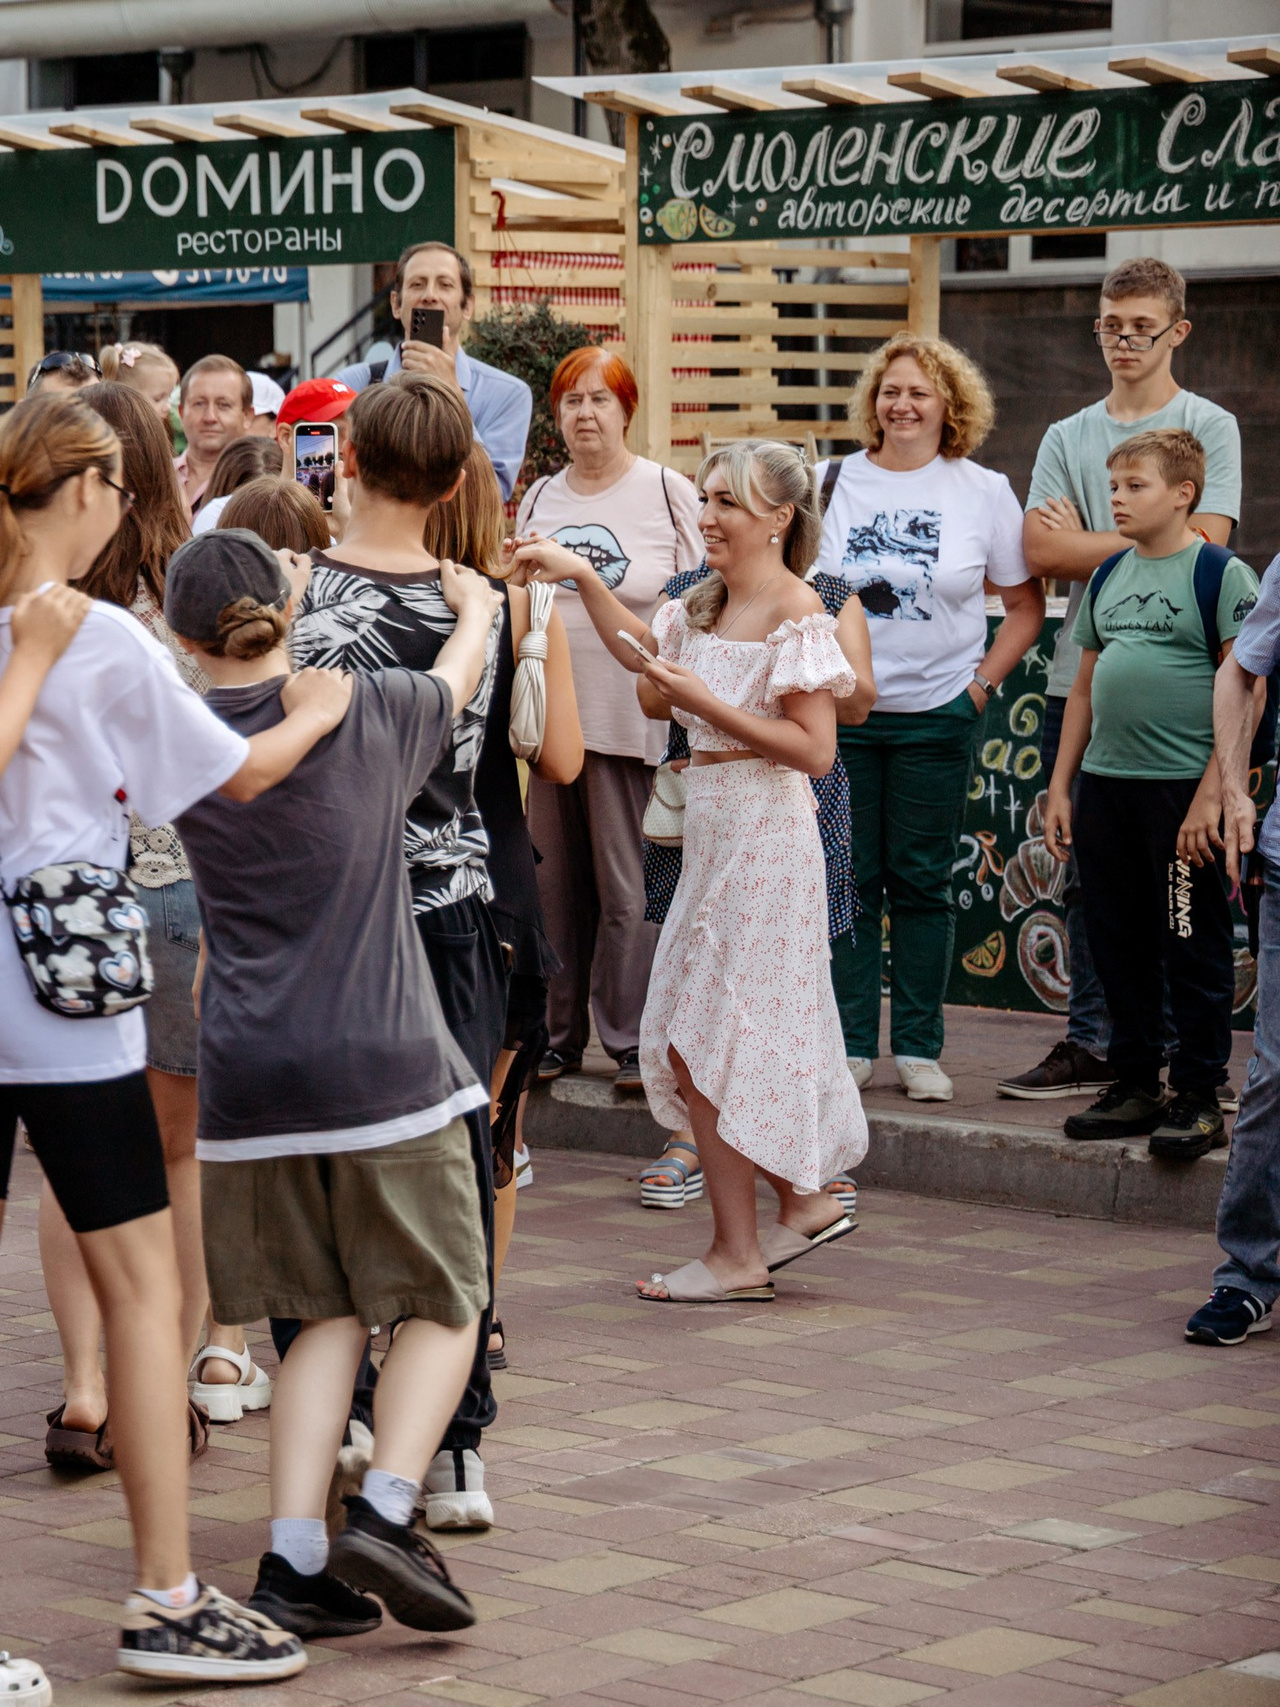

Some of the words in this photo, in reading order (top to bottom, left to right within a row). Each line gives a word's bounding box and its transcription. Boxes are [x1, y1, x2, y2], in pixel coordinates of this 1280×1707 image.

[669, 107, 1102, 199] Смоленские
[777, 185, 972, 236] авторские
[999, 182, 1192, 228] десерты
[1204, 182, 1235, 212] и
[176, 226, 344, 257] рестораны
